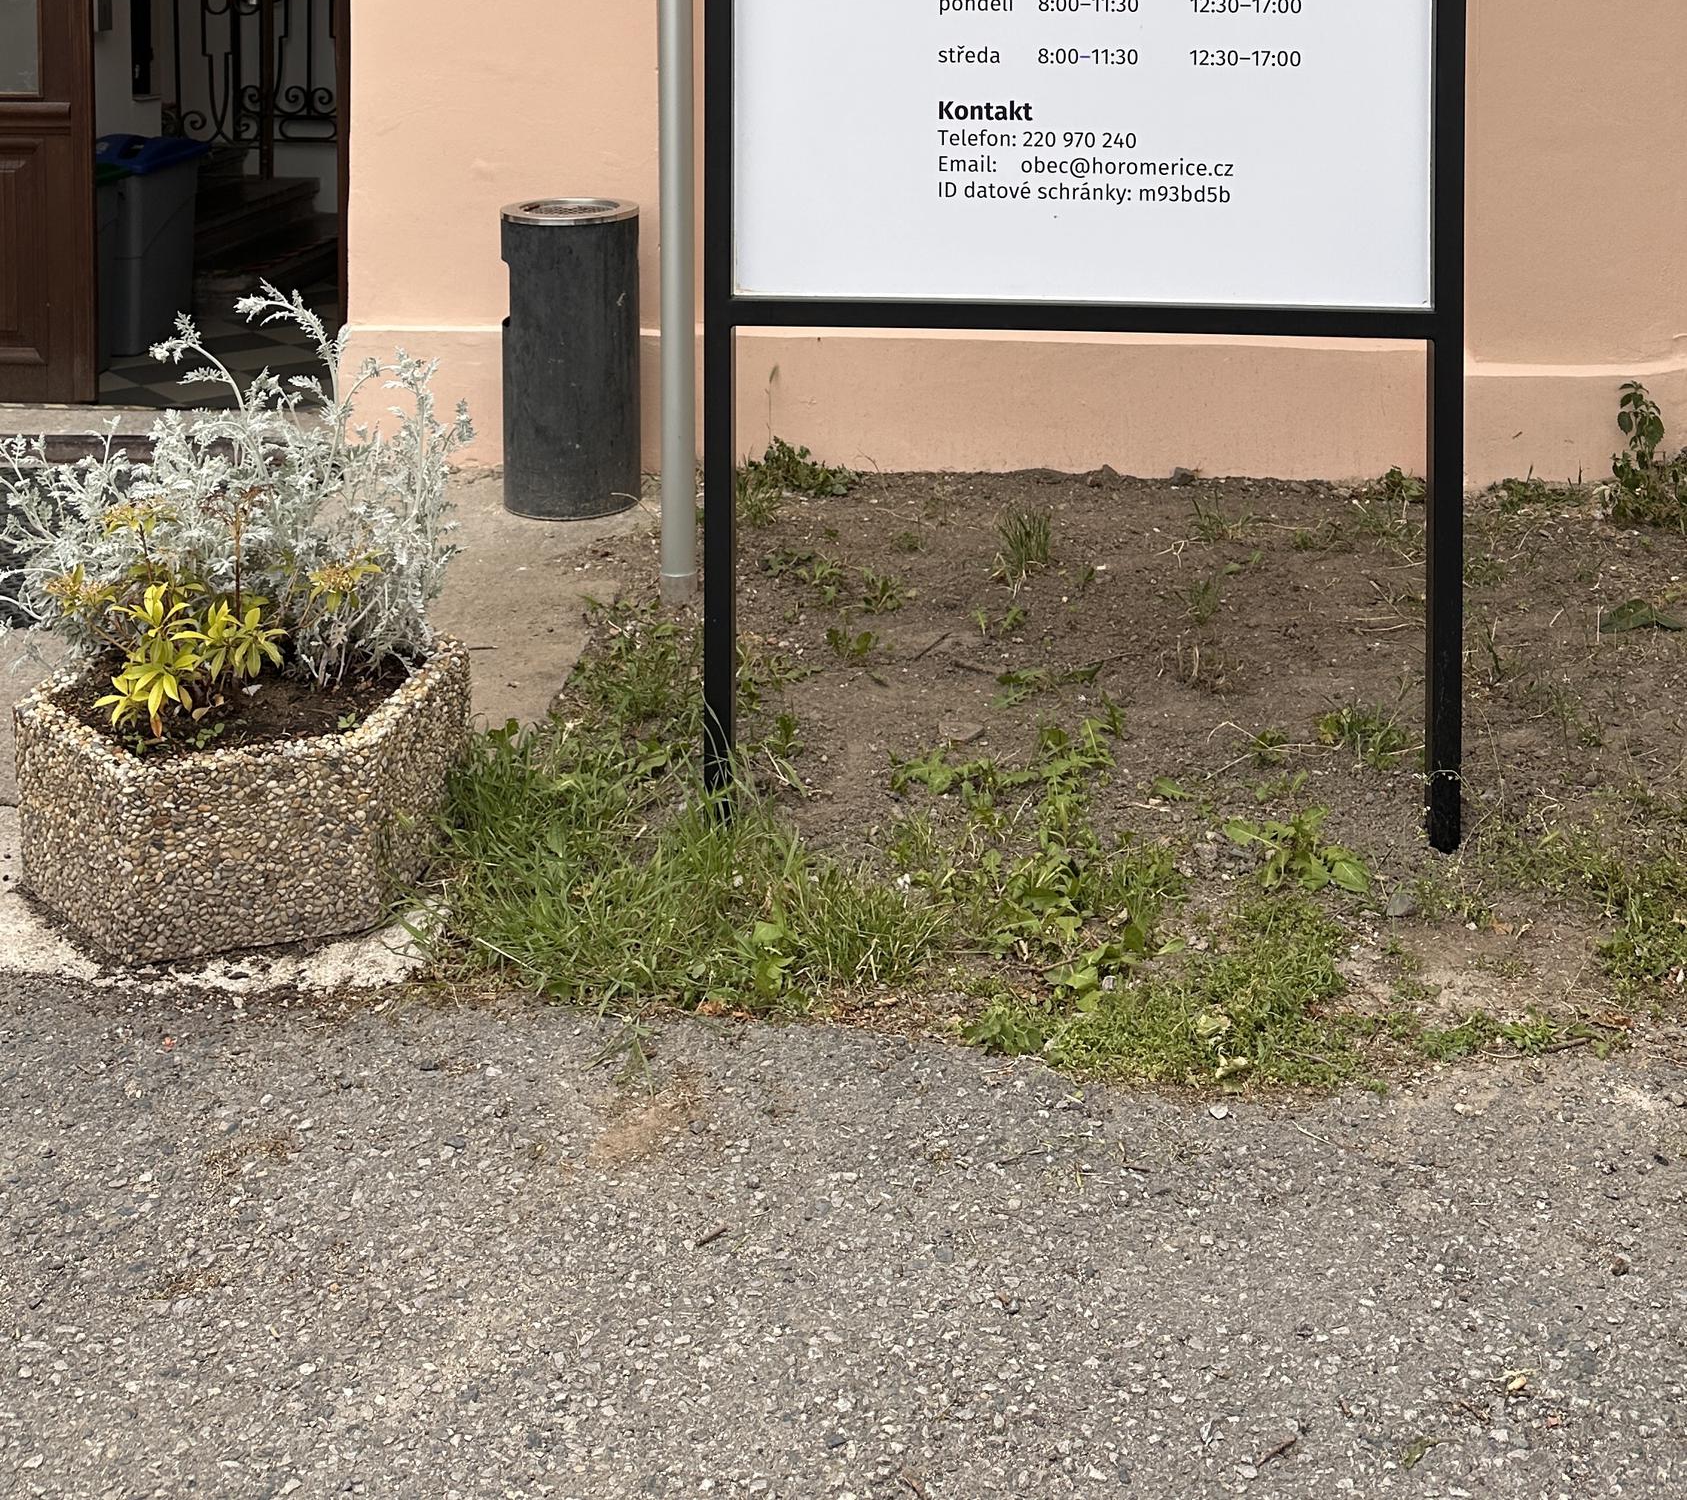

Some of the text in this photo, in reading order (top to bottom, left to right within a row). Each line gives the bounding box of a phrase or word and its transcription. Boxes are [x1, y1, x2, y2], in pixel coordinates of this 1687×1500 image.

[937, 44, 1001, 64] středa
[938, 99, 1034, 122] Kontakt
[936, 128, 1137, 149] Telefon: 220 970 240
[938, 154, 1234, 179] Email: obec@horomerice.cz
[938, 180, 1231, 206] ID datové schránky: m93bd5b
